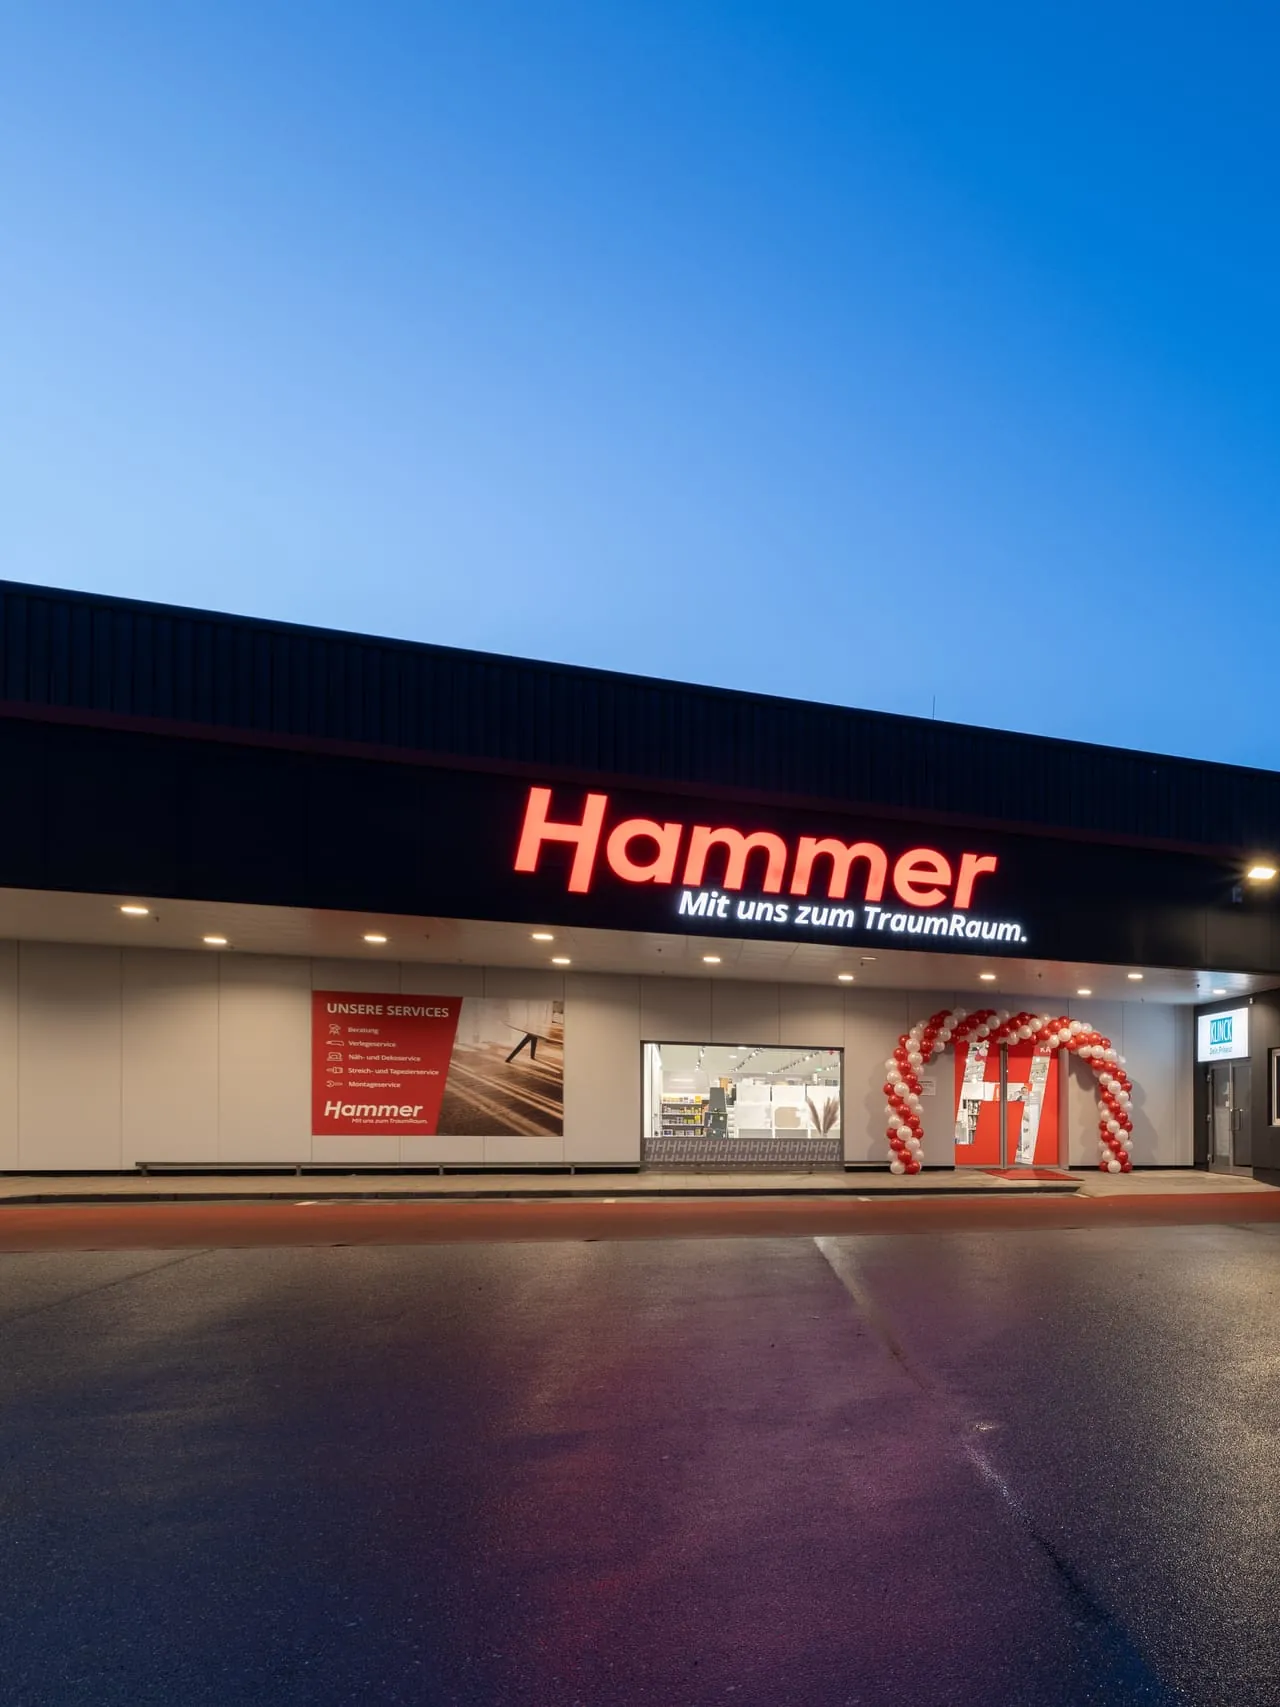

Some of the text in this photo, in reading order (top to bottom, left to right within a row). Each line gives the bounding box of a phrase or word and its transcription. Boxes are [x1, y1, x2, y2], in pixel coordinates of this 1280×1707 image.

[513, 786, 998, 909] Hammer
[678, 891, 1028, 942] Mit uns zum TraumRaum.
[327, 1003, 449, 1018] UNSERE SERVICES
[348, 1027, 379, 1035] Beratung
[1210, 1020, 1232, 1043] KLINCK
[348, 1040, 396, 1048] Verlegeservice
[390, 1068, 439, 1076] Tapezierservice
[324, 1100, 423, 1119] Hammer
